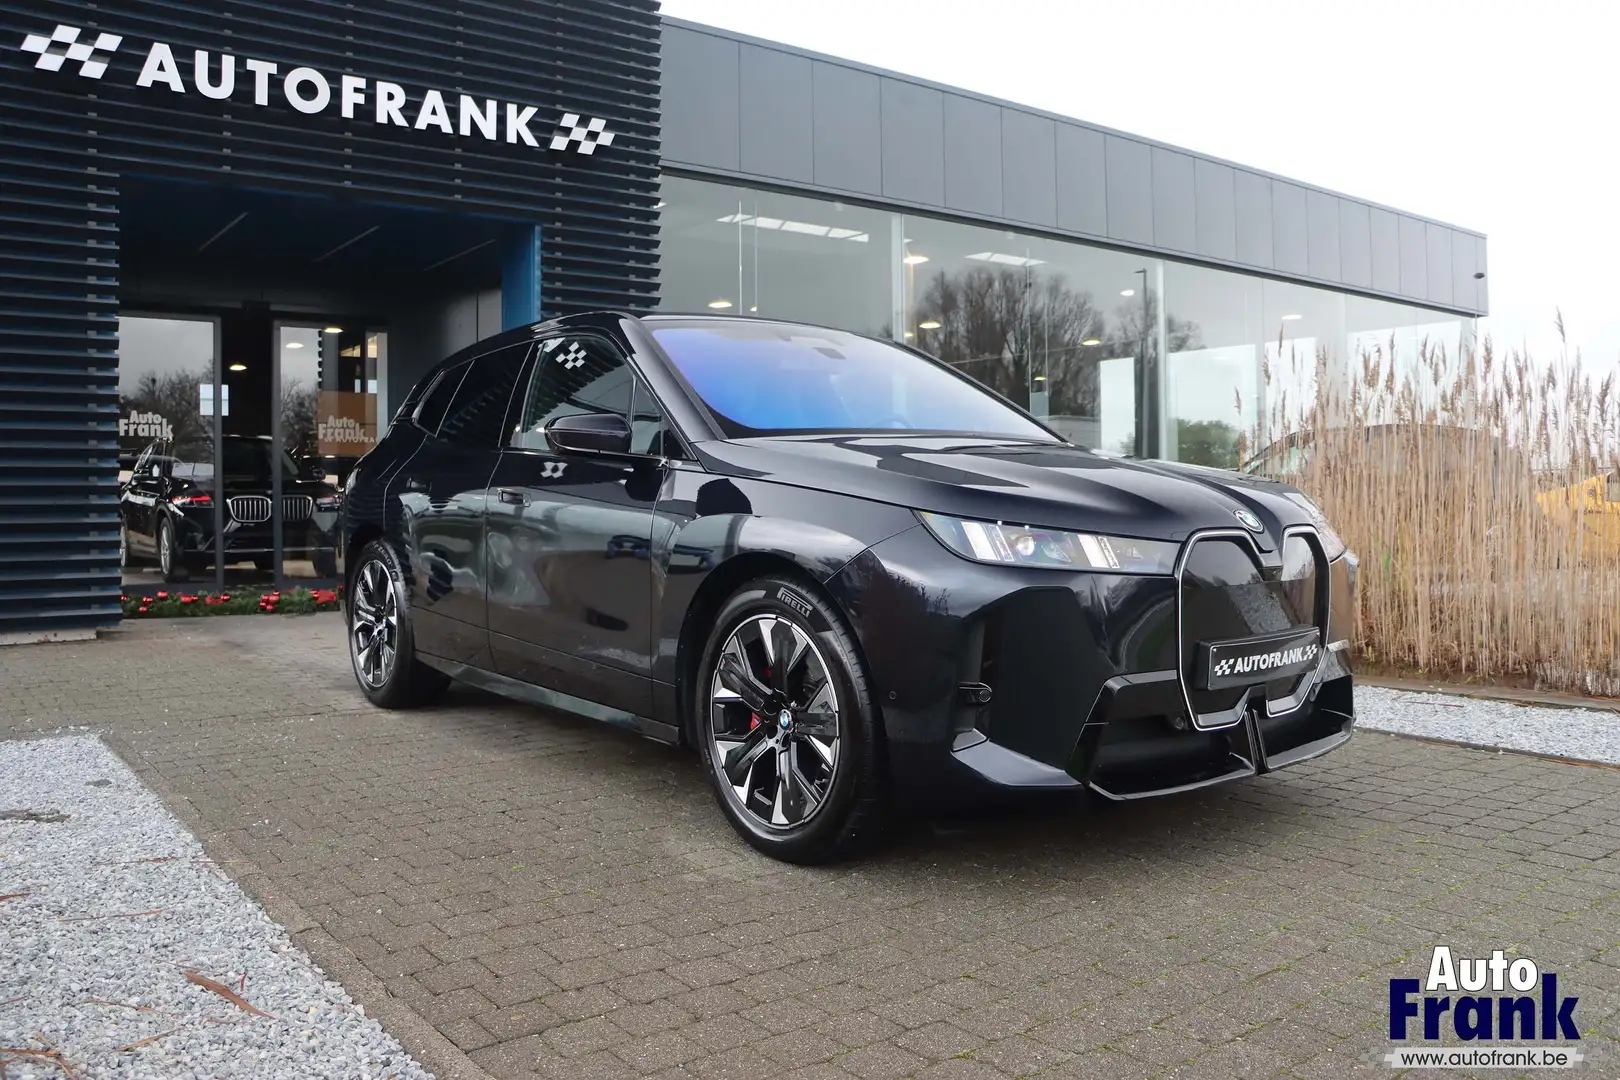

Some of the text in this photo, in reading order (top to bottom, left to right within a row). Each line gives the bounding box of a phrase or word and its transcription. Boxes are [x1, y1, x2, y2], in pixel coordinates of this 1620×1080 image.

[136, 42, 540, 148] AUTOFRANK
[129, 410, 162, 424] Auto
[327, 414, 356, 428] Auto
[118, 418, 174, 437] Frank
[318, 423, 366, 440] Frank
[776, 587, 813, 618] PIRELLI
[1234, 647, 1304, 673] AUTOFRANK
